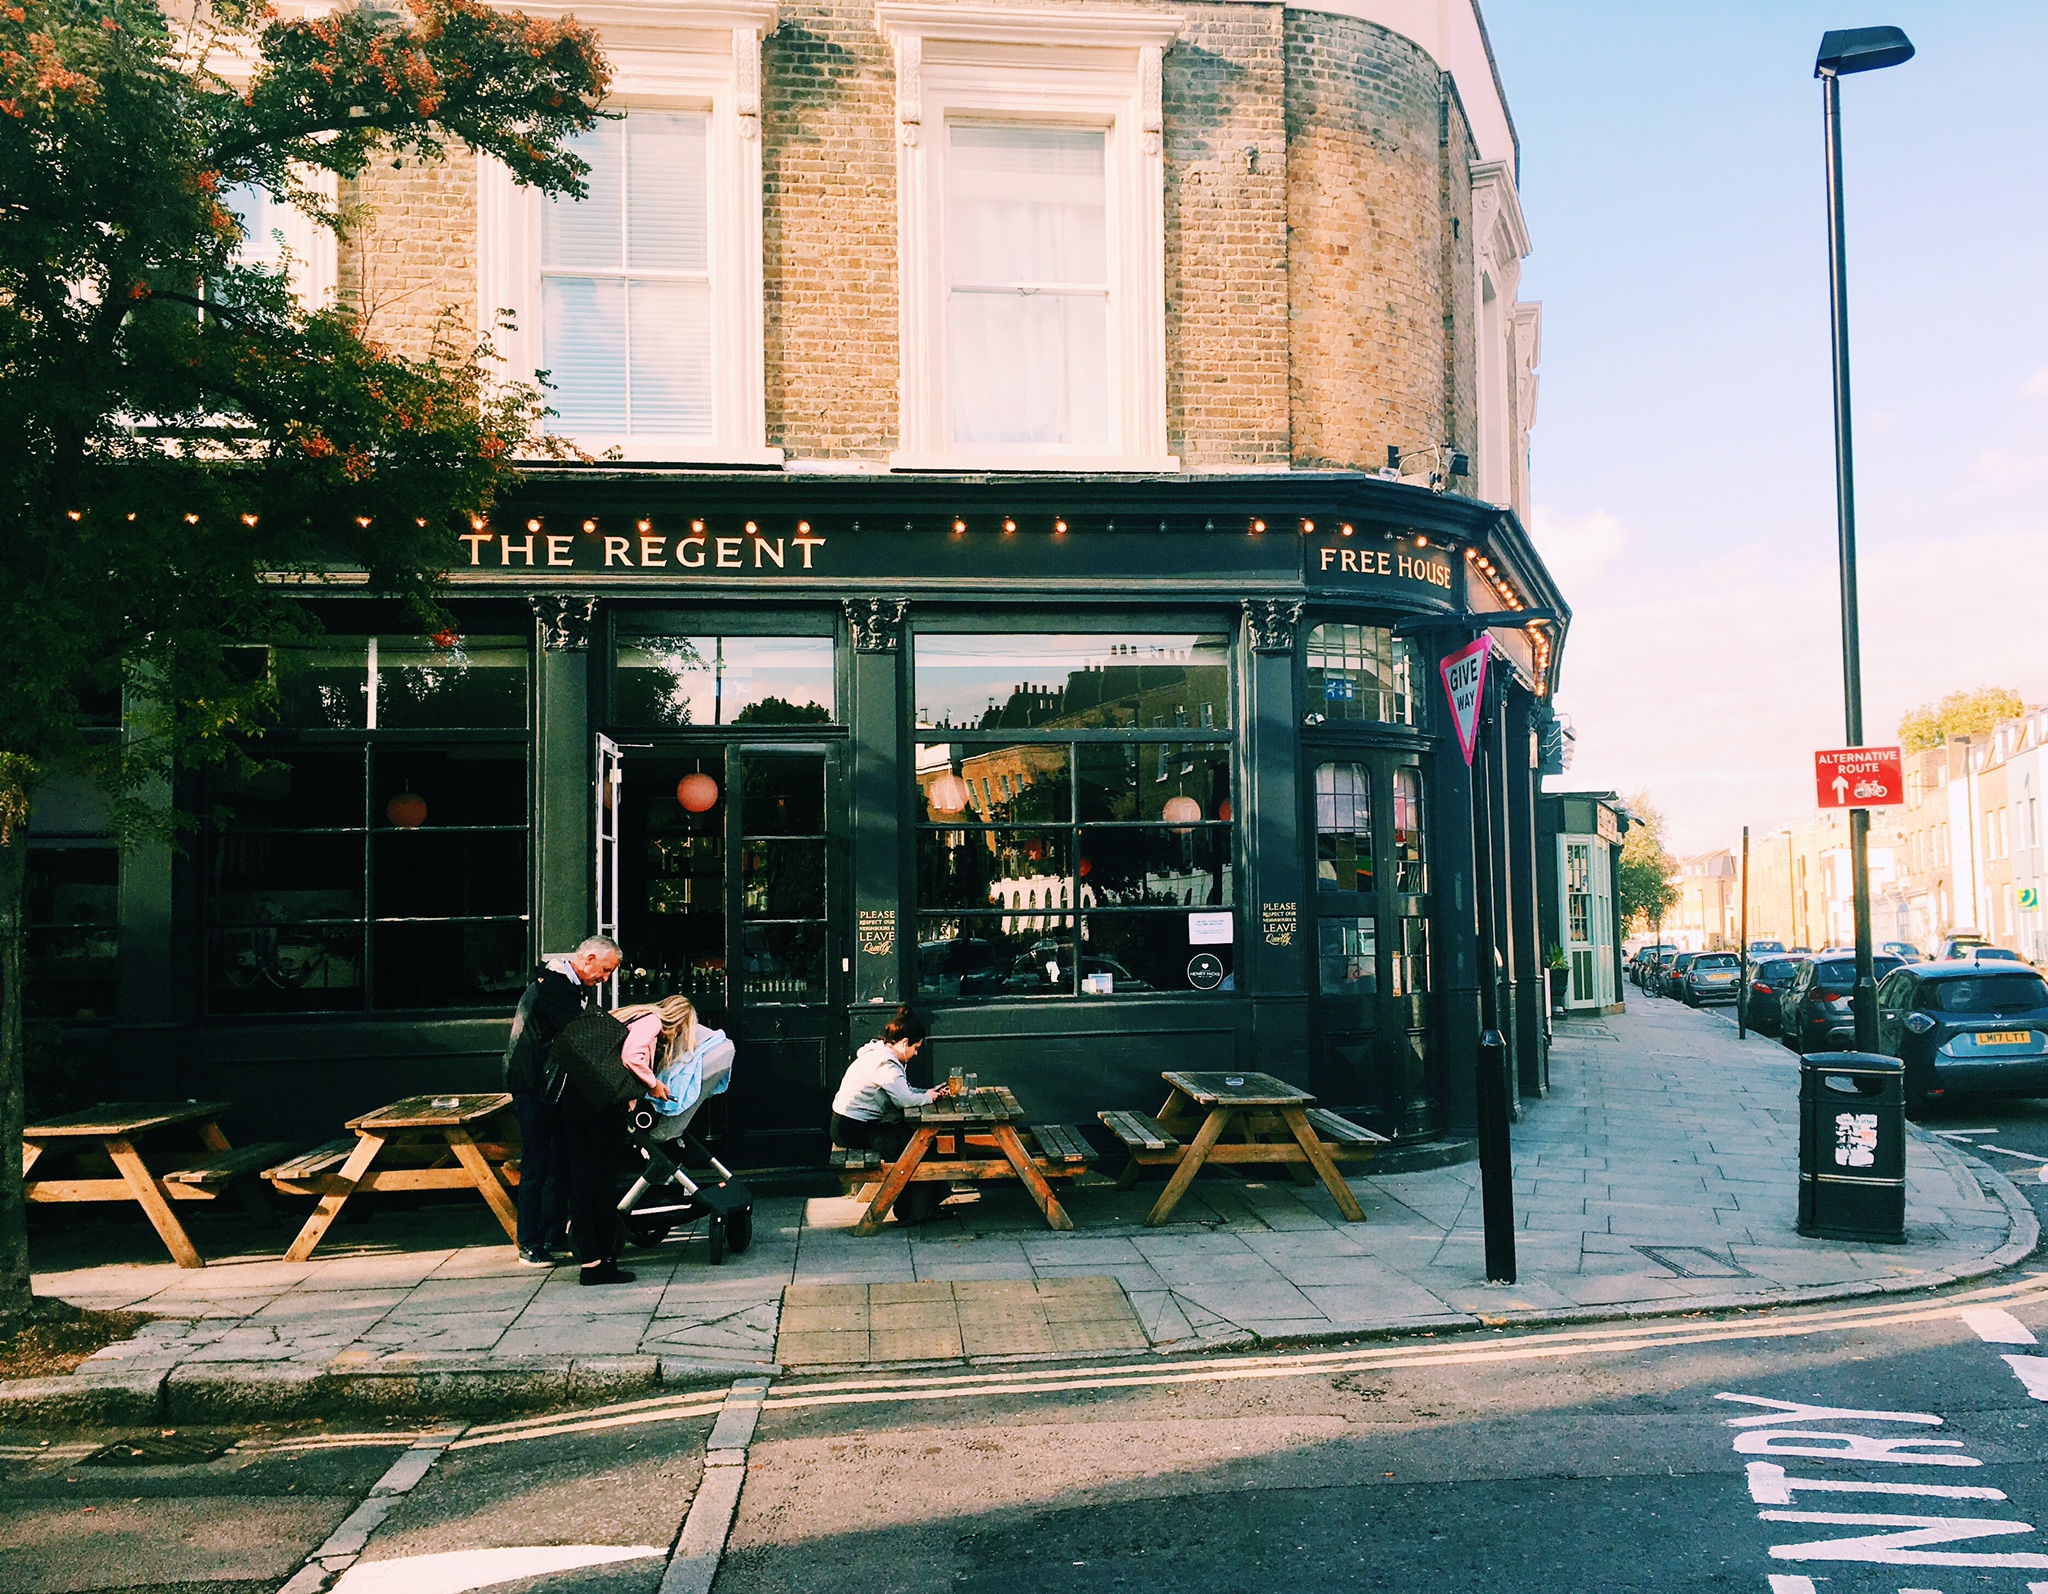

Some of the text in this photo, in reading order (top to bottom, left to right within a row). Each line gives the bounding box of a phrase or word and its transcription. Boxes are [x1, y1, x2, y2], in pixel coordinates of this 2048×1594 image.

[459, 534, 827, 569] THE REGENT
[1320, 548, 1452, 590] FREE HOUSE
[1450, 658, 1478, 691] GIVE
[1456, 690, 1475, 712] WAY
[1818, 751, 1898, 764] ALTERNATIVE
[1838, 763, 1879, 774] ROUTE
[1263, 902, 1296, 911] PLEASE
[860, 910, 896, 918] PLEASE
[1263, 923, 1297, 932] LEAVE
[859, 931, 896, 941] LEAVE
[1979, 1032, 2026, 1044] LM17 LTT
[1714, 1392, 2048, 1594] NTRY
